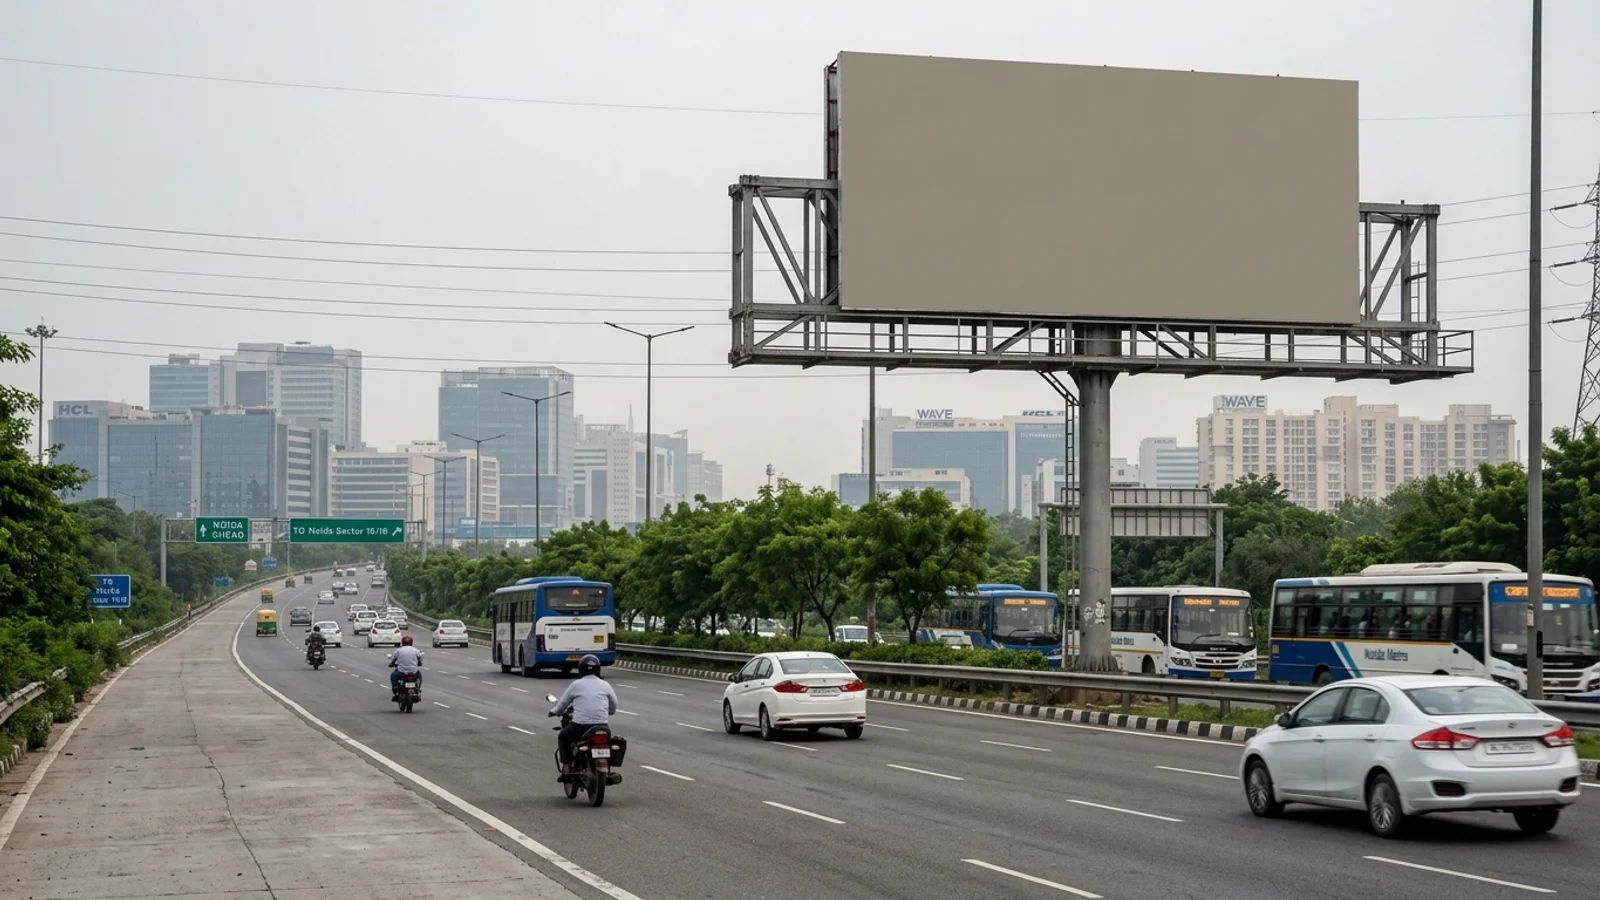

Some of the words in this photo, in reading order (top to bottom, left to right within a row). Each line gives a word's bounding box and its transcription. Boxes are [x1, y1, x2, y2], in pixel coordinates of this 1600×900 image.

[1225, 395, 1265, 407] WAVE
[58, 404, 93, 415] HCL
[916, 408, 953, 420] WAVE
[293, 526, 305, 535] TO
[336, 526, 364, 535] Sector
